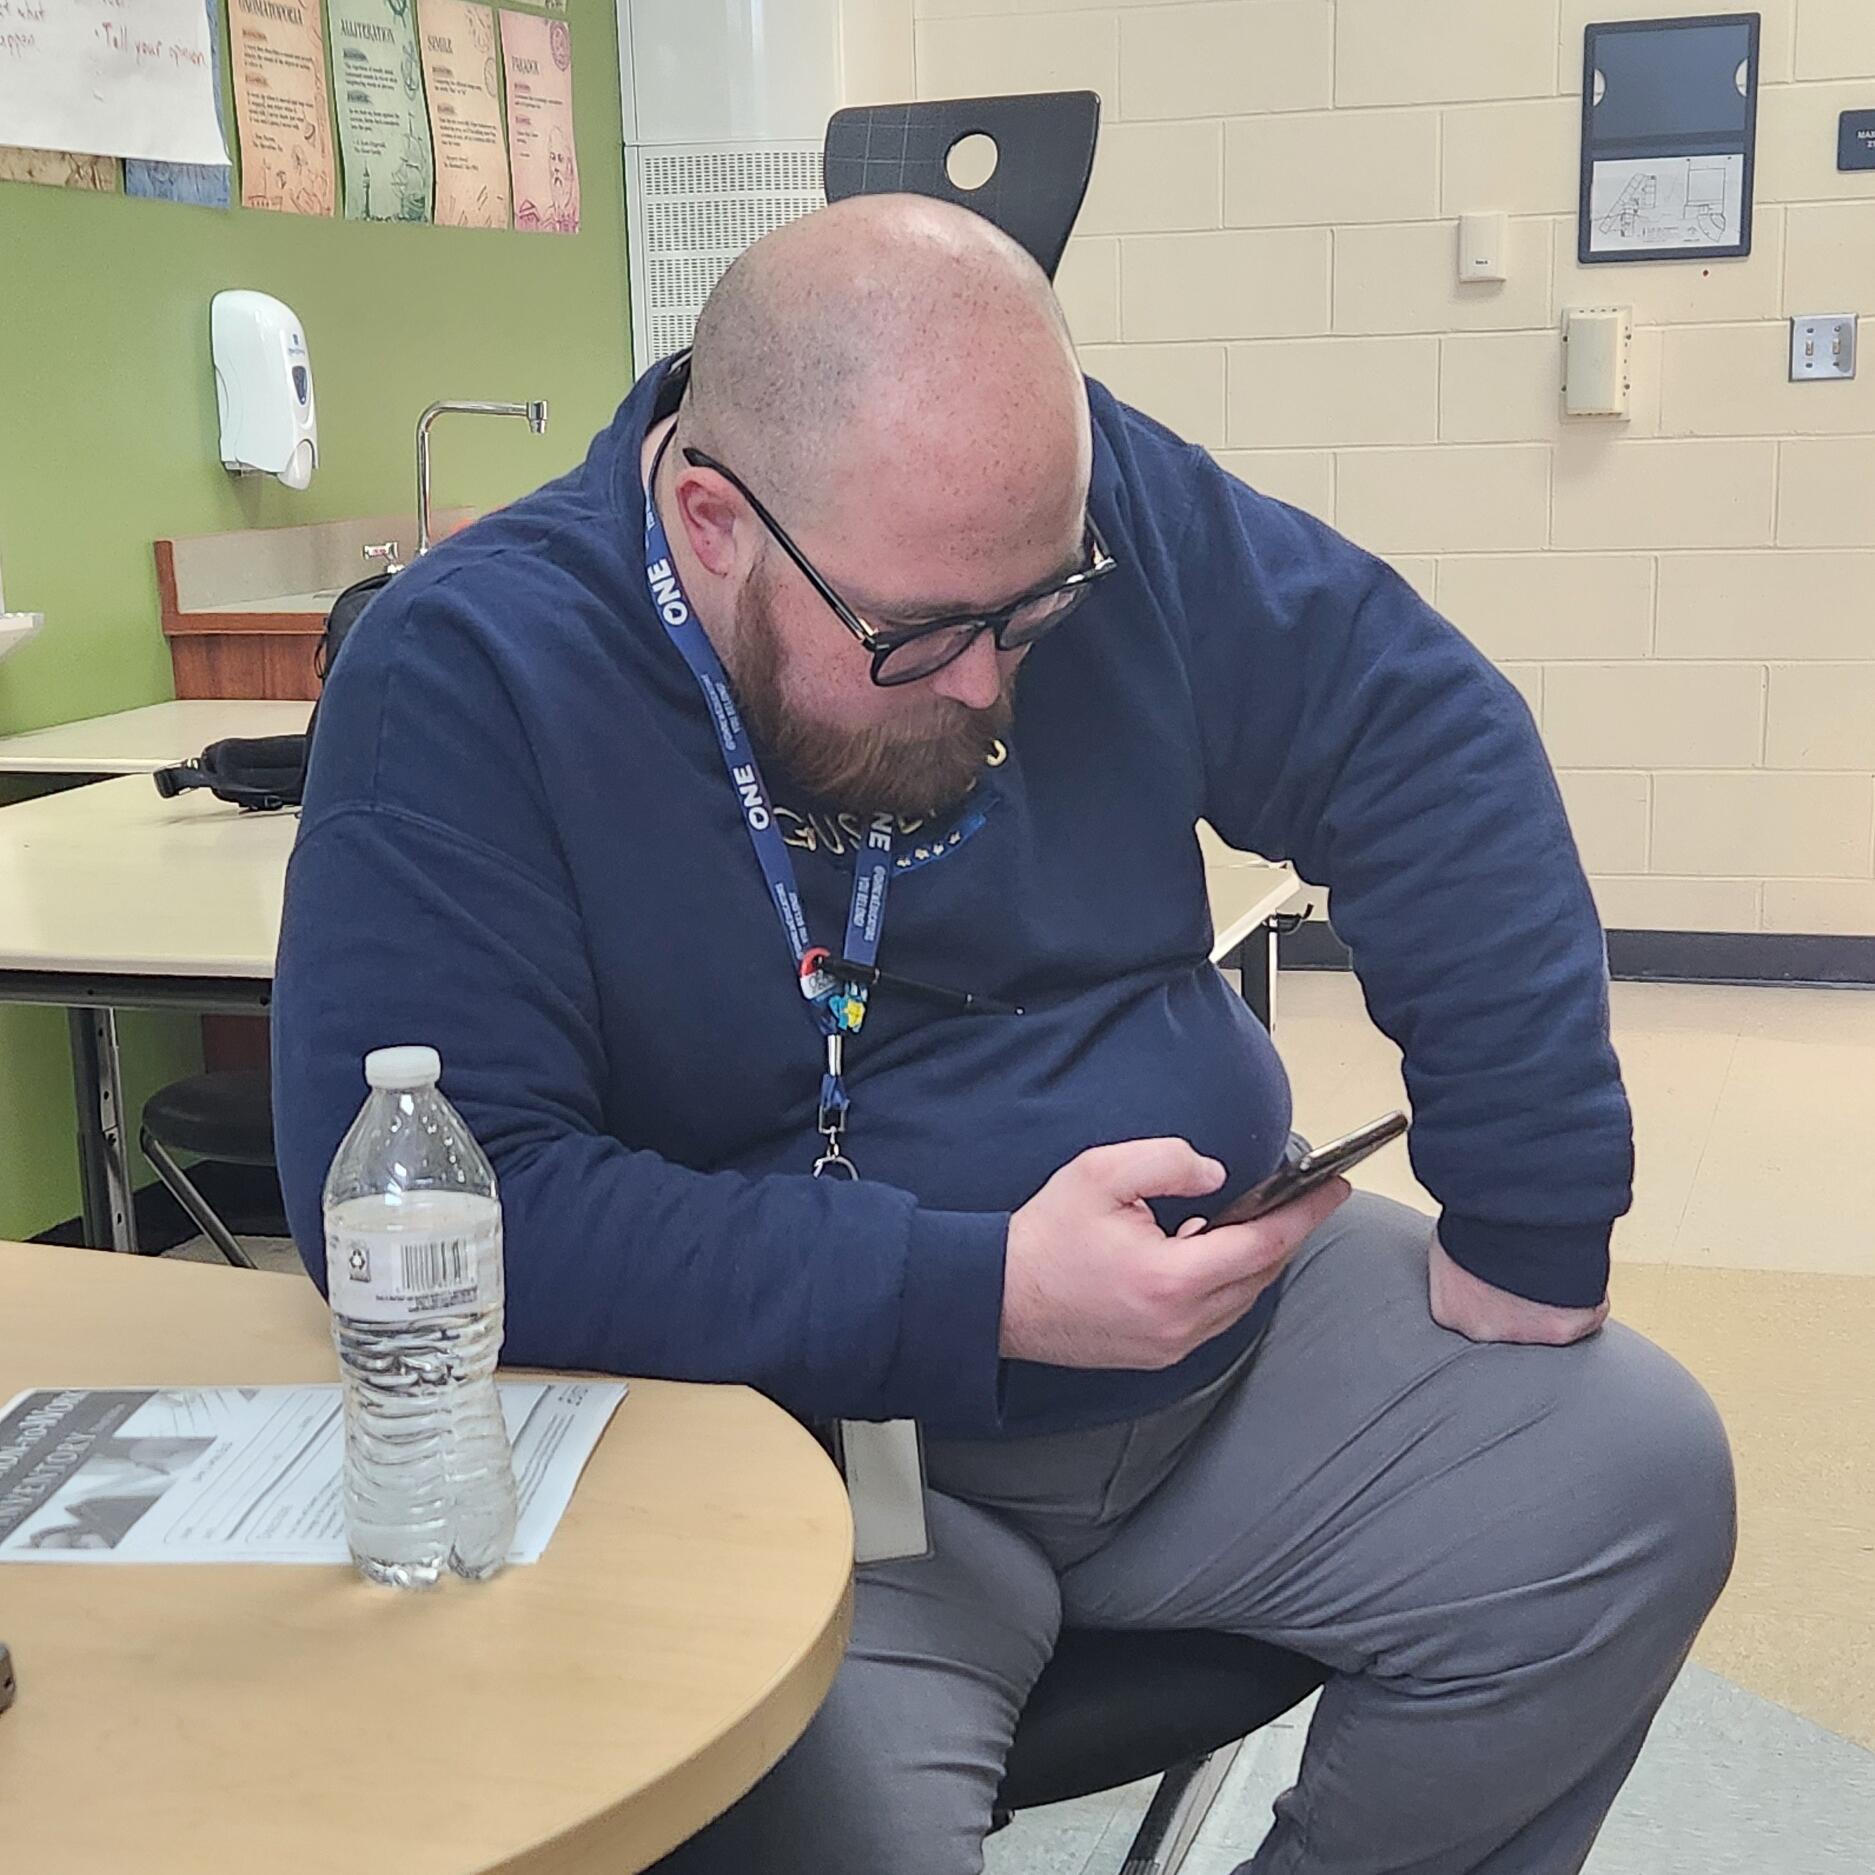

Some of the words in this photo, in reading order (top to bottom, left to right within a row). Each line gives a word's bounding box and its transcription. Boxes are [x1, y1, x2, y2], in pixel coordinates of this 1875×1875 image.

[646, 558, 689, 626] ONE
[732, 763, 770, 831] ONE
[869, 812, 895, 852] NE
